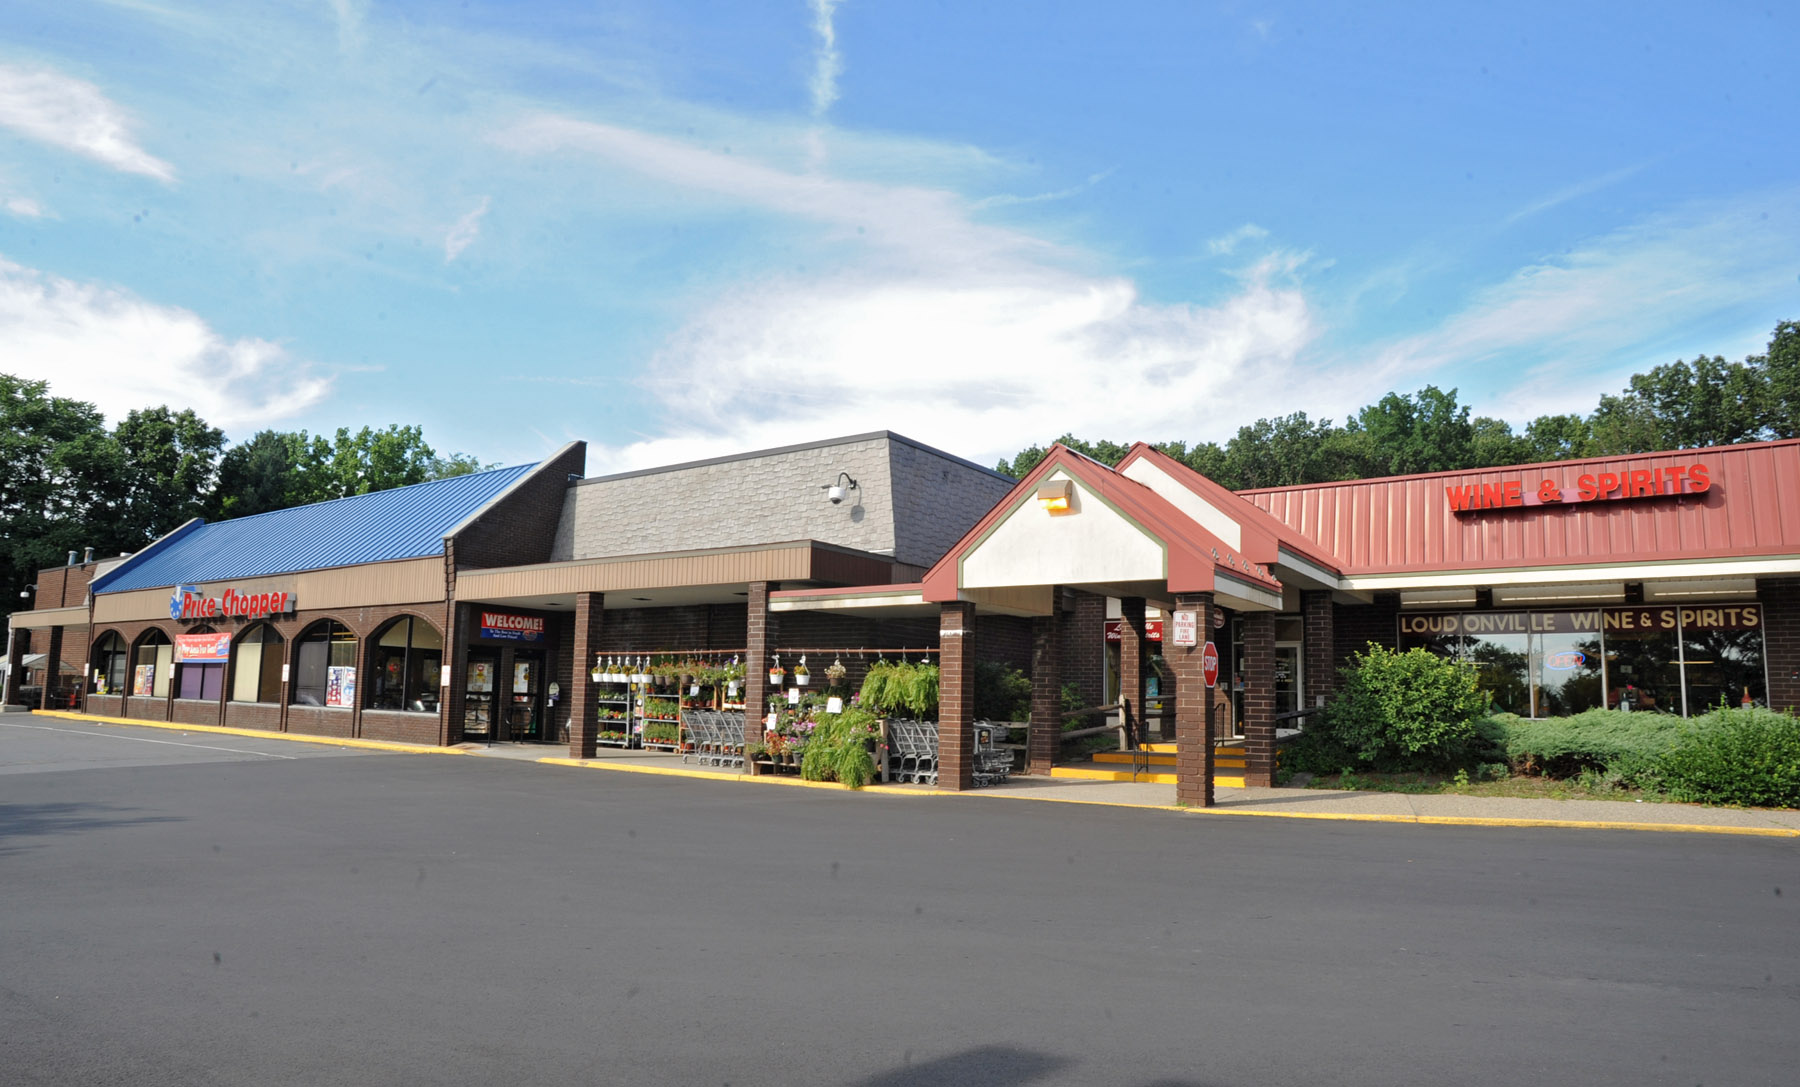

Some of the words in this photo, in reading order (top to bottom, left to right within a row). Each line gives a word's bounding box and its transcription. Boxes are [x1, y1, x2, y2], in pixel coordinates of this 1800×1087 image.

[1446, 481, 1523, 510] WINE
[1537, 479, 1562, 502] &
[1578, 464, 1711, 501] SPIRITS
[182, 592, 216, 618] Price
[222, 588, 288, 619] Chopper
[485, 613, 543, 630] WELCOME!
[1175, 621, 1195, 629] PARKING
[1570, 612, 1635, 630] WINE
[1639, 612, 1652, 627] &
[1660, 607, 1759, 629] SPIRITS
[1204, 655, 1217, 671] STOP
[1546, 654, 1583, 667] OPEN
